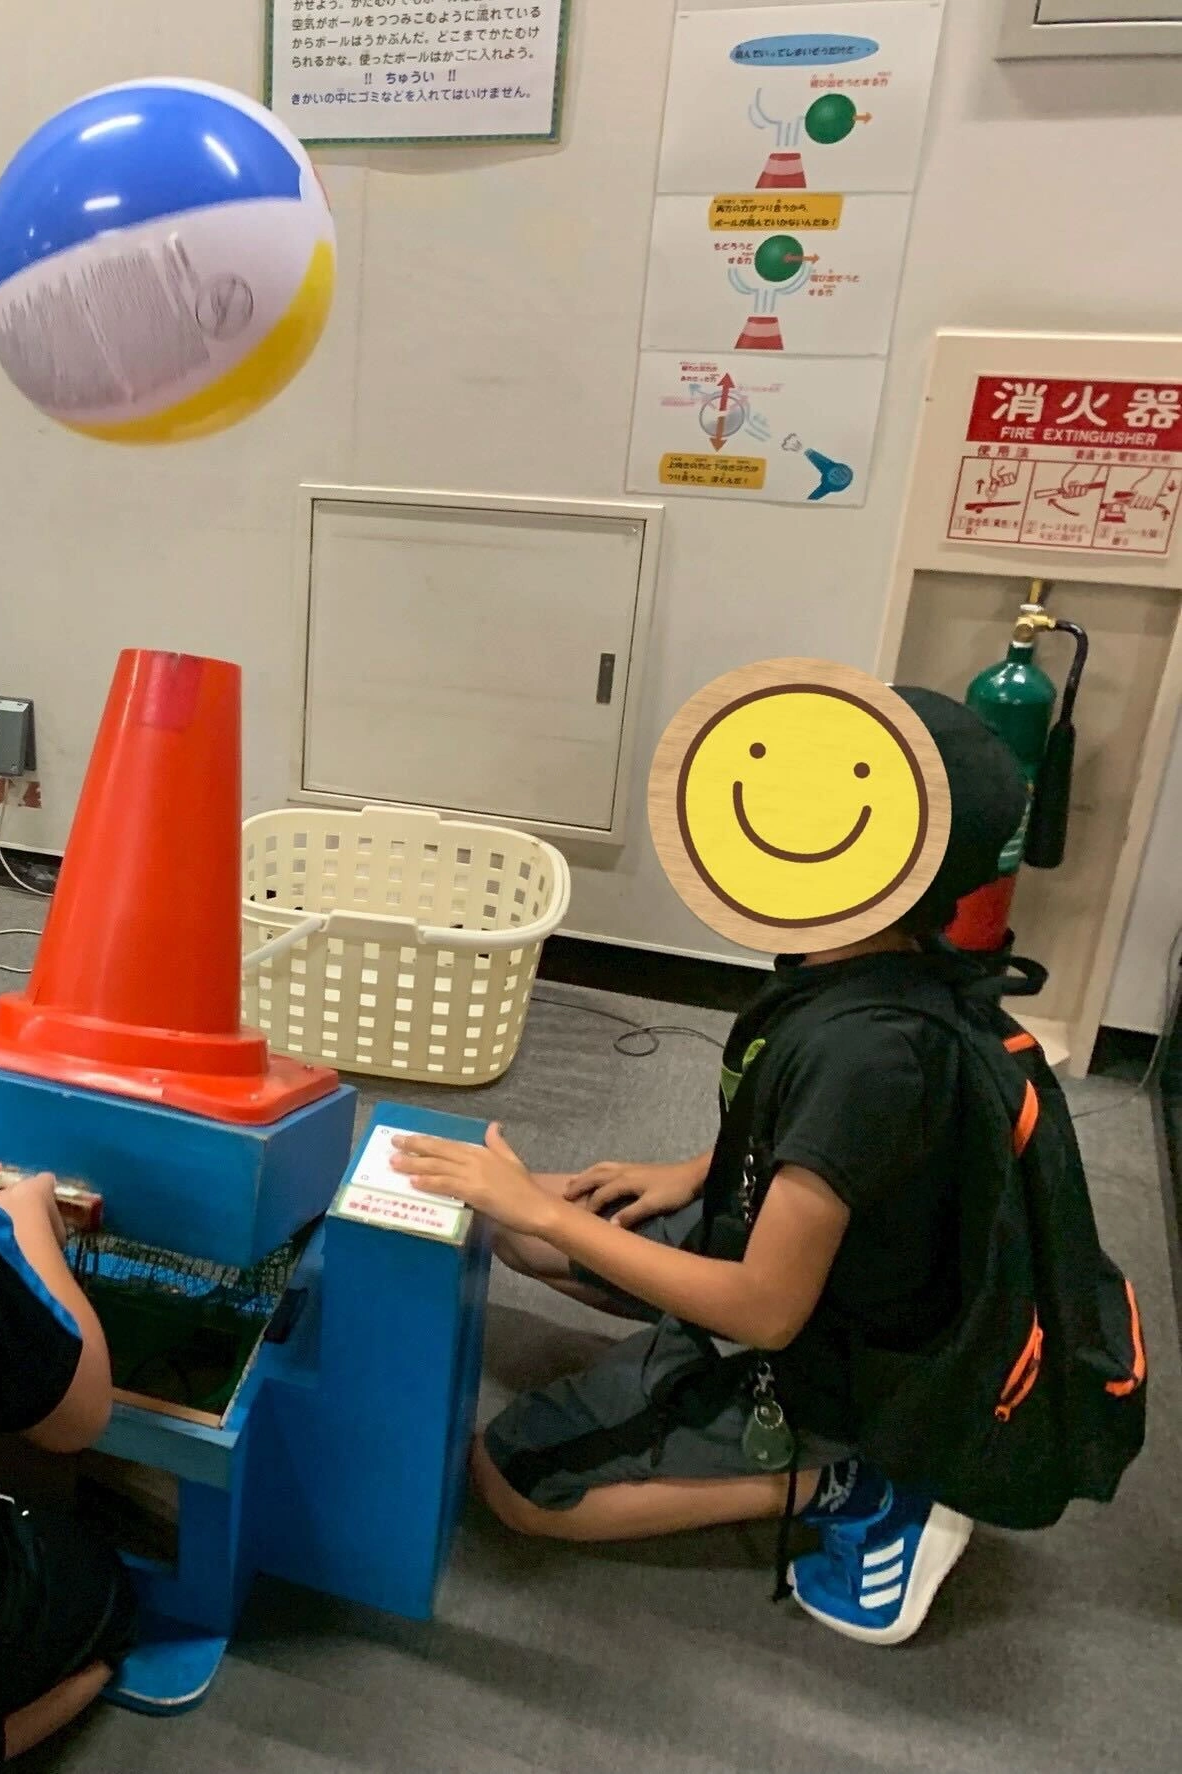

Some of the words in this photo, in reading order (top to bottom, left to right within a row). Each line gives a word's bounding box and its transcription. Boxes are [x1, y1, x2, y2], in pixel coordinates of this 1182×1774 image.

[385, 71, 435, 84] ちゅうい
[291, 87, 532, 105] きかいの中にゴミなどを入れてはいけません。
[991, 381, 1181, 430] 消火器
[1000, 426, 1036, 440] FIRE
[1043, 428, 1158, 446] EXTINGUISHER
